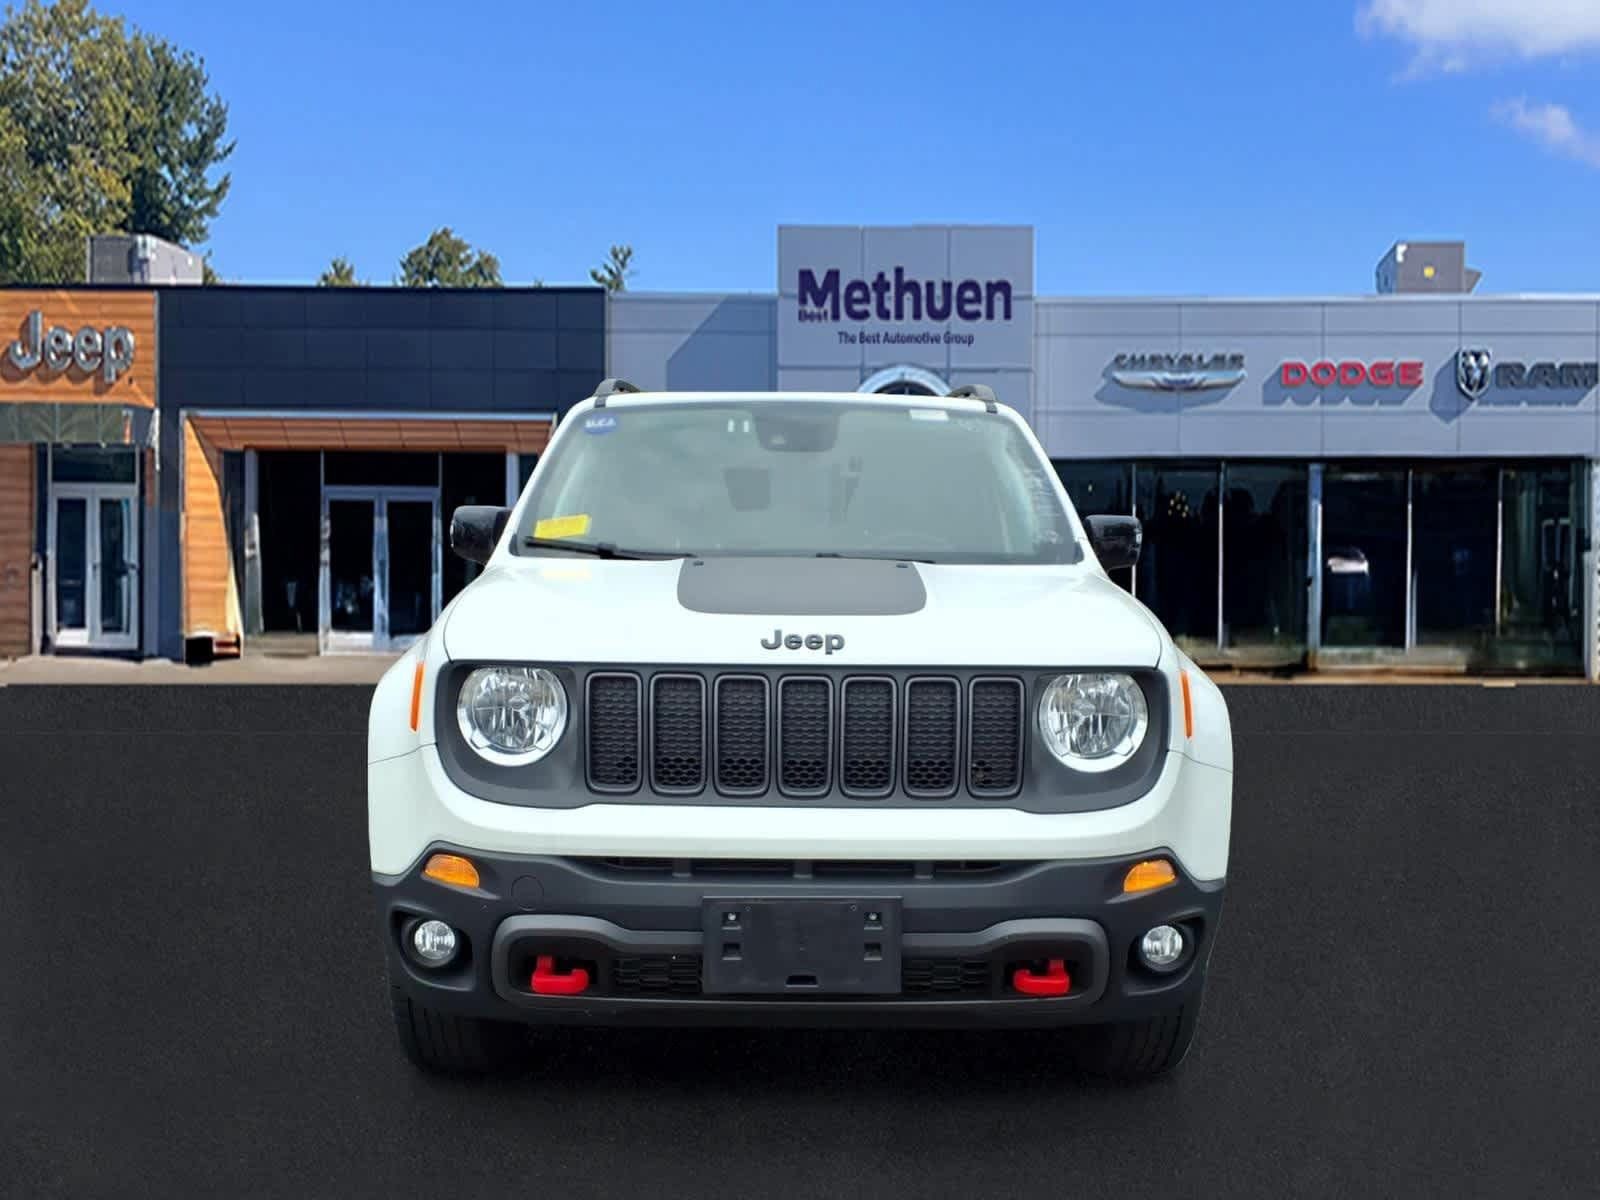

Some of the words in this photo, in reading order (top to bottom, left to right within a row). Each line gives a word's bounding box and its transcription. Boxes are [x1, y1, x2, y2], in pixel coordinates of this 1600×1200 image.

[798, 266, 1012, 322] Methuen
[9, 310, 135, 383] Jeep
[838, 331, 857, 345] The
[859, 331, 881, 345] Best
[883, 331, 941, 345] Automotive
[943, 331, 975, 347] Group
[1281, 360, 1425, 386] DODGE
[1495, 362, 1599, 389] RAM
[760, 629, 846, 655] Jeep
